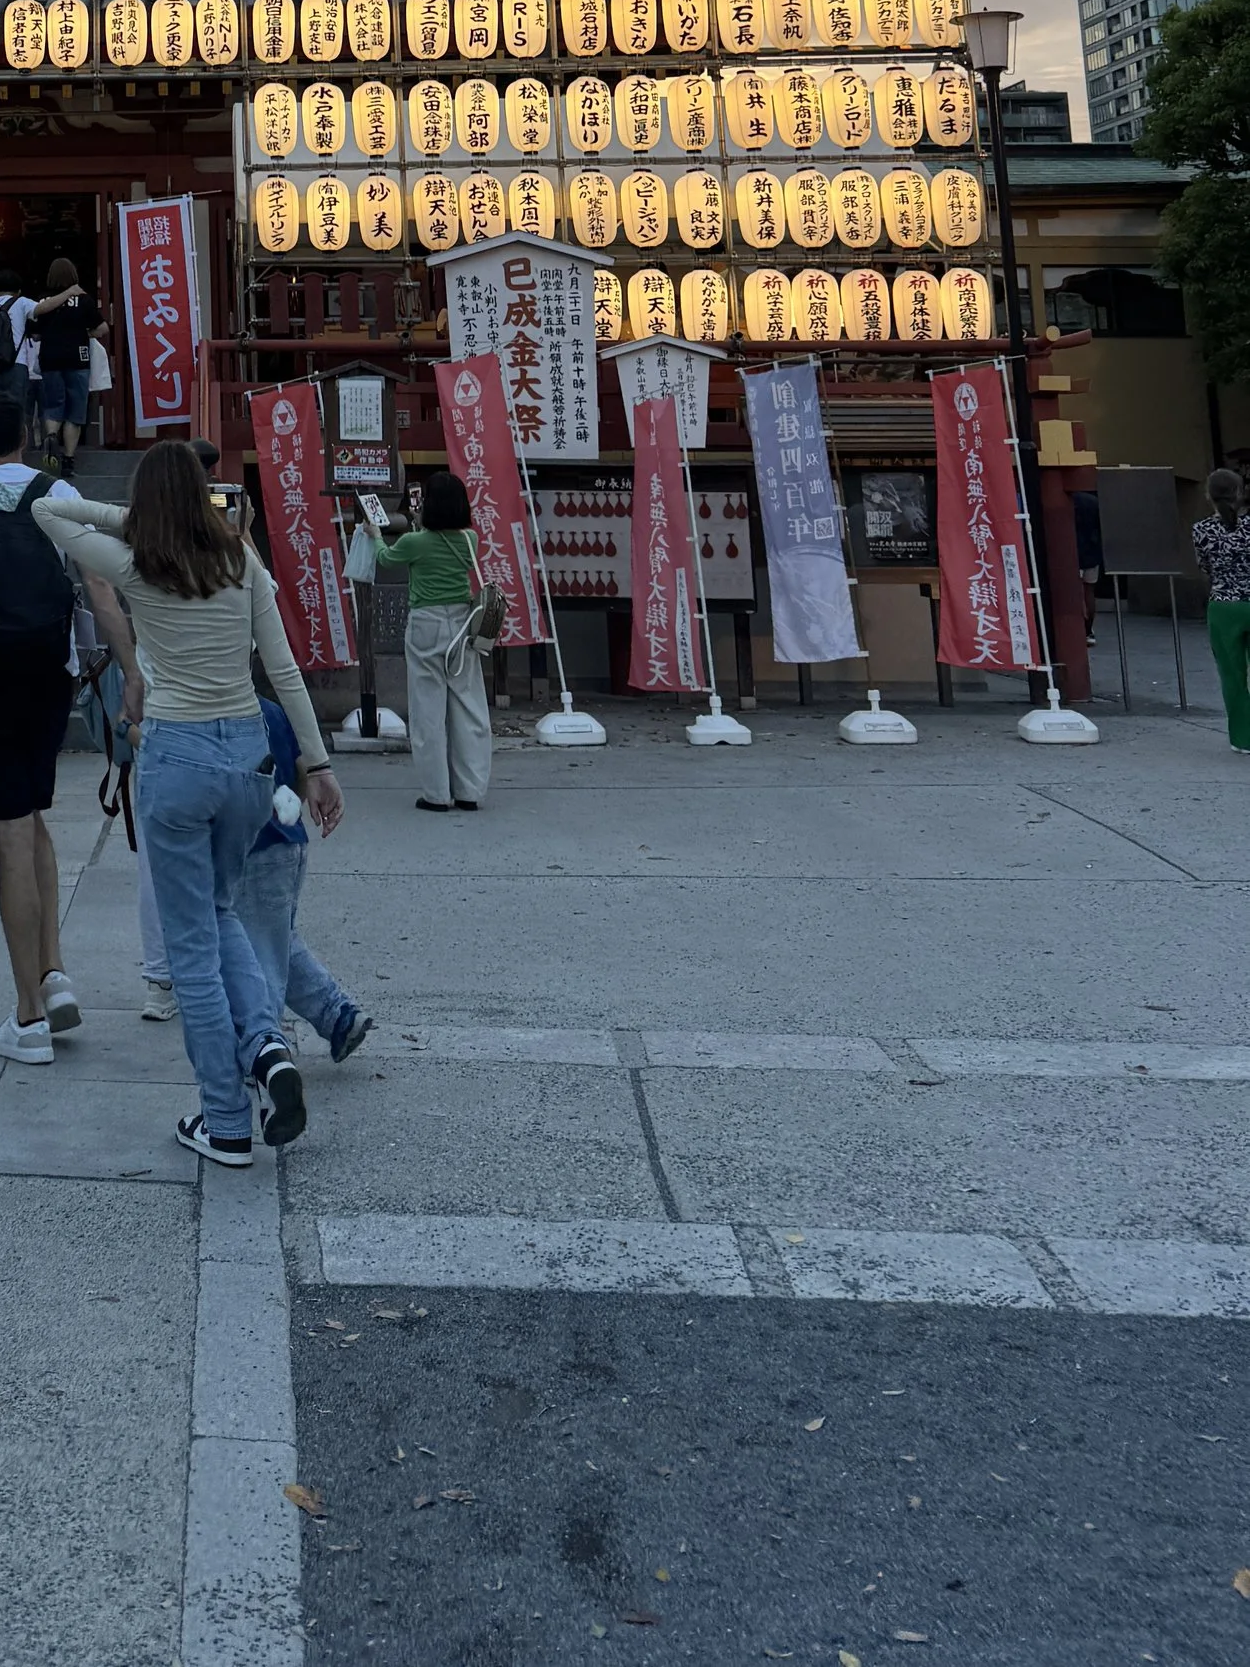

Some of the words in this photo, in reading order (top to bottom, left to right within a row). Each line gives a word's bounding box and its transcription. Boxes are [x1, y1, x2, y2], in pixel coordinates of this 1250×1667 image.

[57, 0, 77, 62] 村上由紀子
[579, 81, 600, 144] なかほり
[840, 76, 862, 140] クリーンロード
[938, 76, 959, 135] だるま
[753, 178, 778, 240] 新井美保
